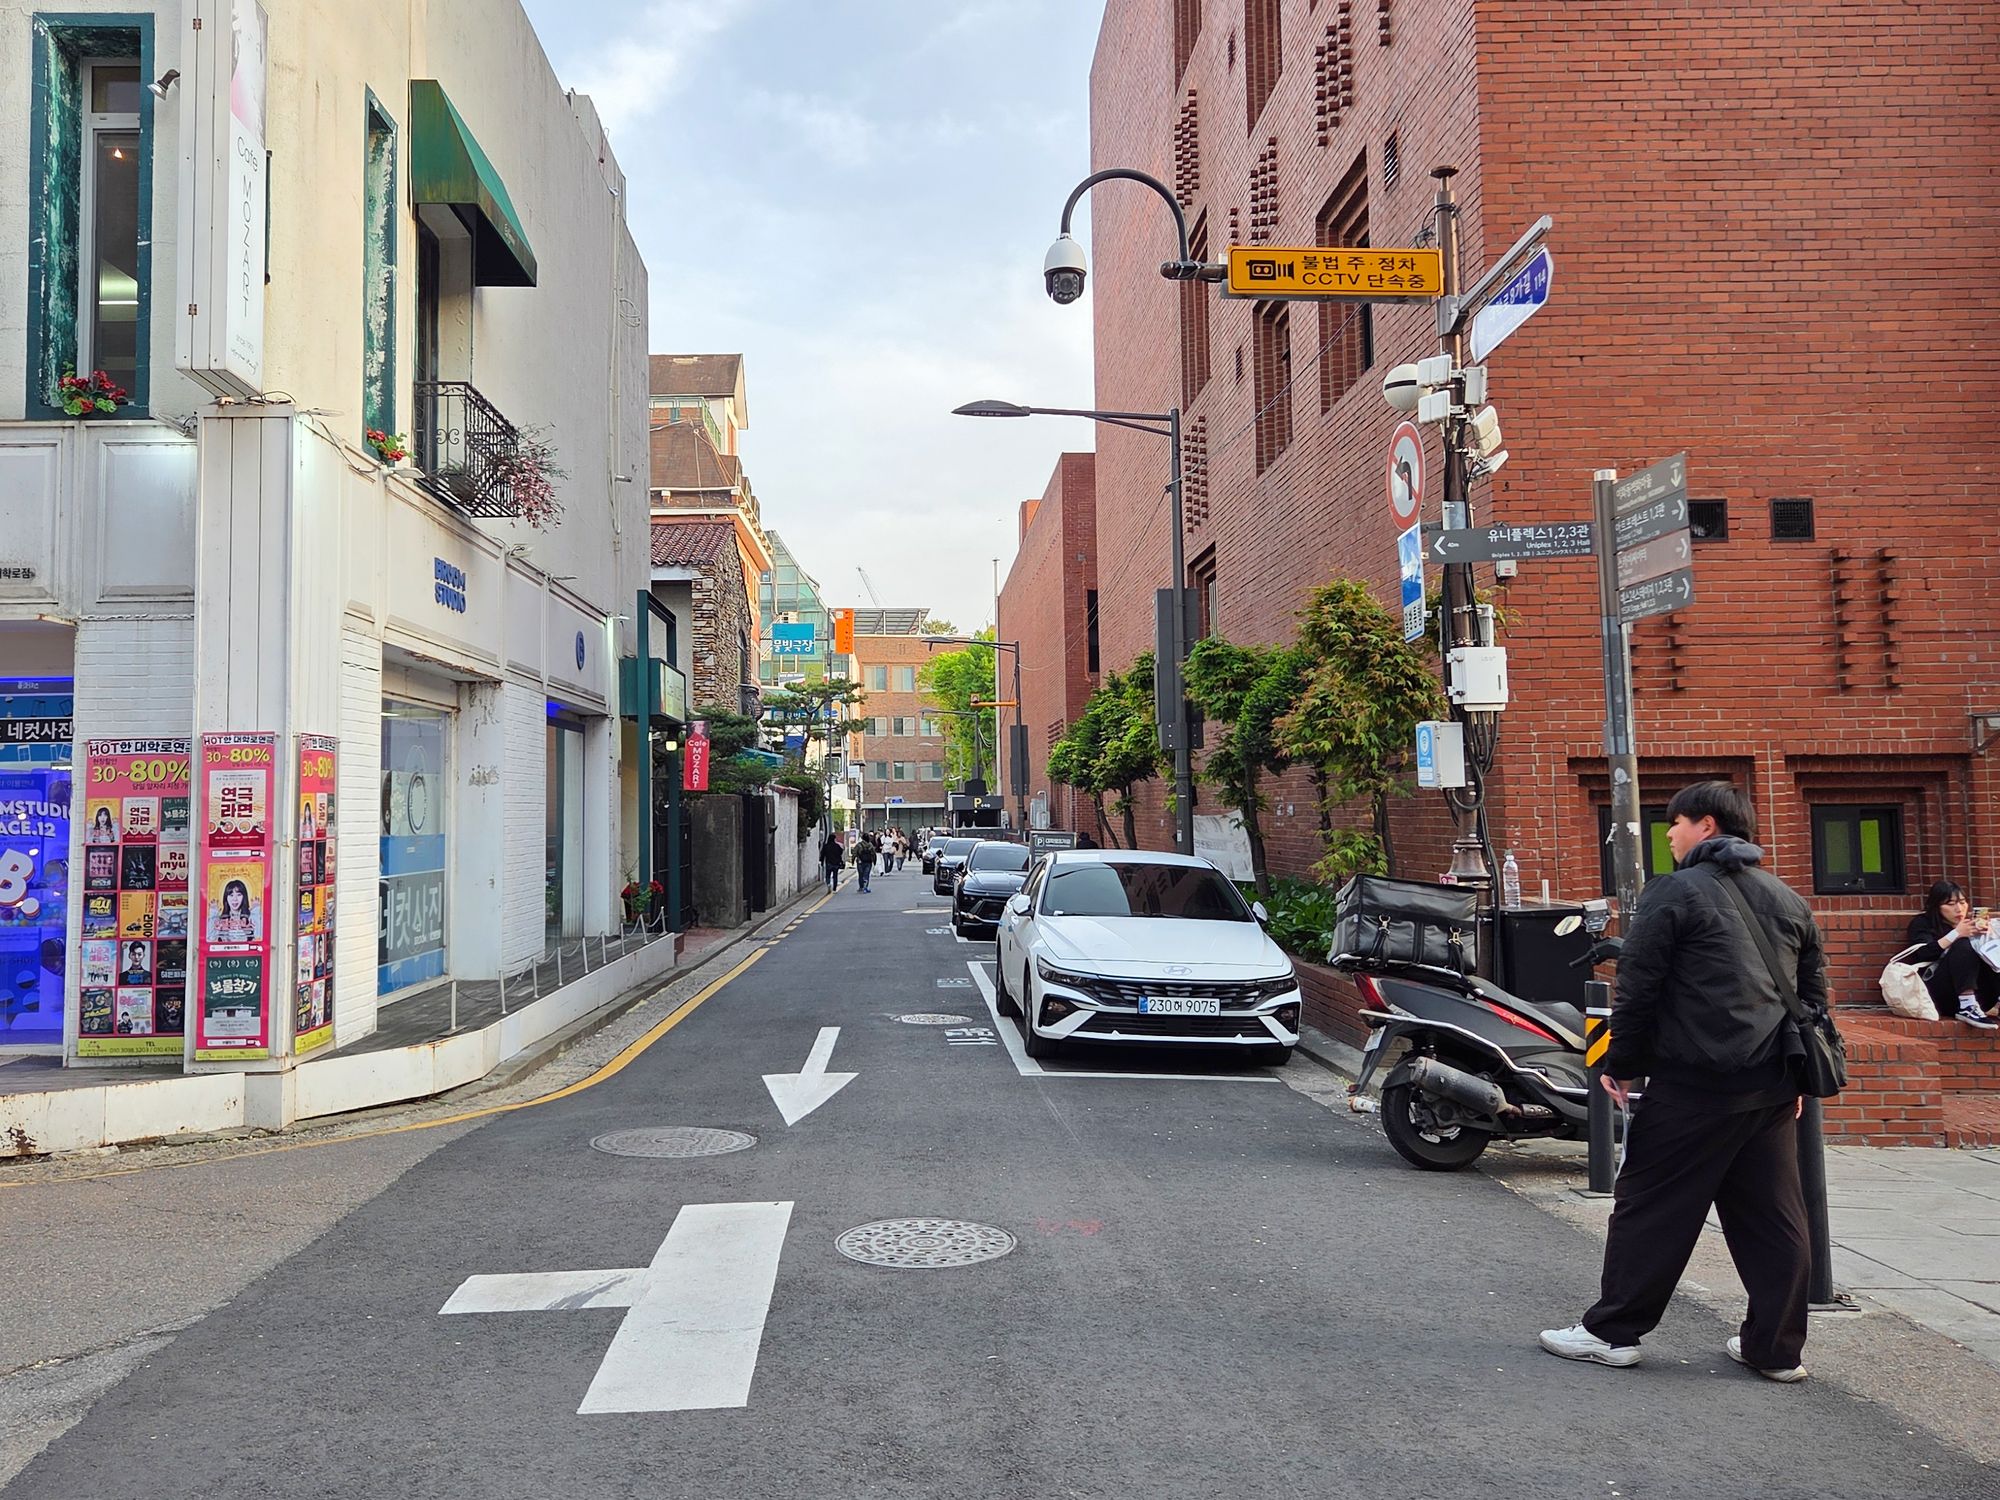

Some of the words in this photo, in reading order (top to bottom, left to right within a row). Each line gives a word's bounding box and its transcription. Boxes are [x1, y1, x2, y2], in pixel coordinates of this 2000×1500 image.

[237, 136, 258, 172] Cafe
[242, 175, 252, 317] MOZART
[1301, 254, 1339, 271] 불법
[1302, 272, 1360, 287] CCTV
[1367, 273, 1426, 289] 단속중
[1487, 524, 1590, 542] 유니플렉스1,2,3관
[435, 582, 466, 614] STUDIO
[773, 639, 813, 652] 물빛극장
[7, 721, 73, 741] 네컷사진
[89, 741, 132, 756] HOT한
[206, 748, 270, 763] 30~80%
[91, 759, 190, 783] 30~80%
[692, 747, 702, 788] MOZART
[221, 787, 253, 802] 연극
[974, 797, 982, 808] P
[221, 803, 253, 818] 라면
[0, 821, 56, 837] ACE.12
[130, 816, 150, 826] 라면
[169, 852, 185, 860] Ra
[210, 978, 257, 994] 보물찾기
[1185, 1000, 1217, 1013] 9075
